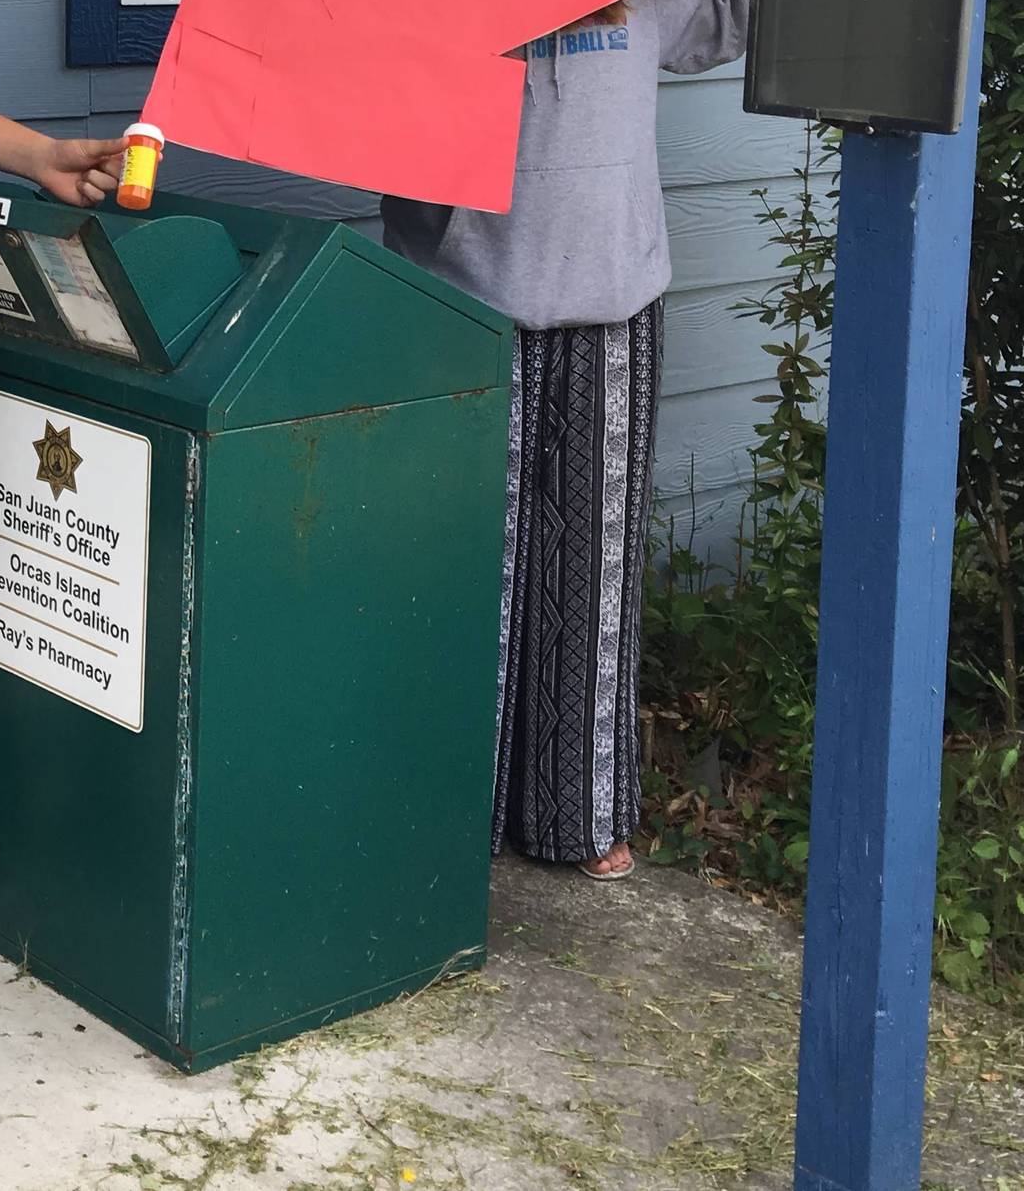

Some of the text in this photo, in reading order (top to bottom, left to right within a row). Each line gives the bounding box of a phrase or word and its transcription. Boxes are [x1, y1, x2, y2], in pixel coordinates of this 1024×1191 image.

[532, 32, 605, 58] OOTBALL
[3, 508, 111, 567] Sheriff's Office
[26, 495, 61, 524] Juan
[66, 509, 120, 550] County
[10, 553, 101, 607] Orcas Island
[63, 600, 130, 644] Coalition
[39, 637, 112, 691] Pharmacy
